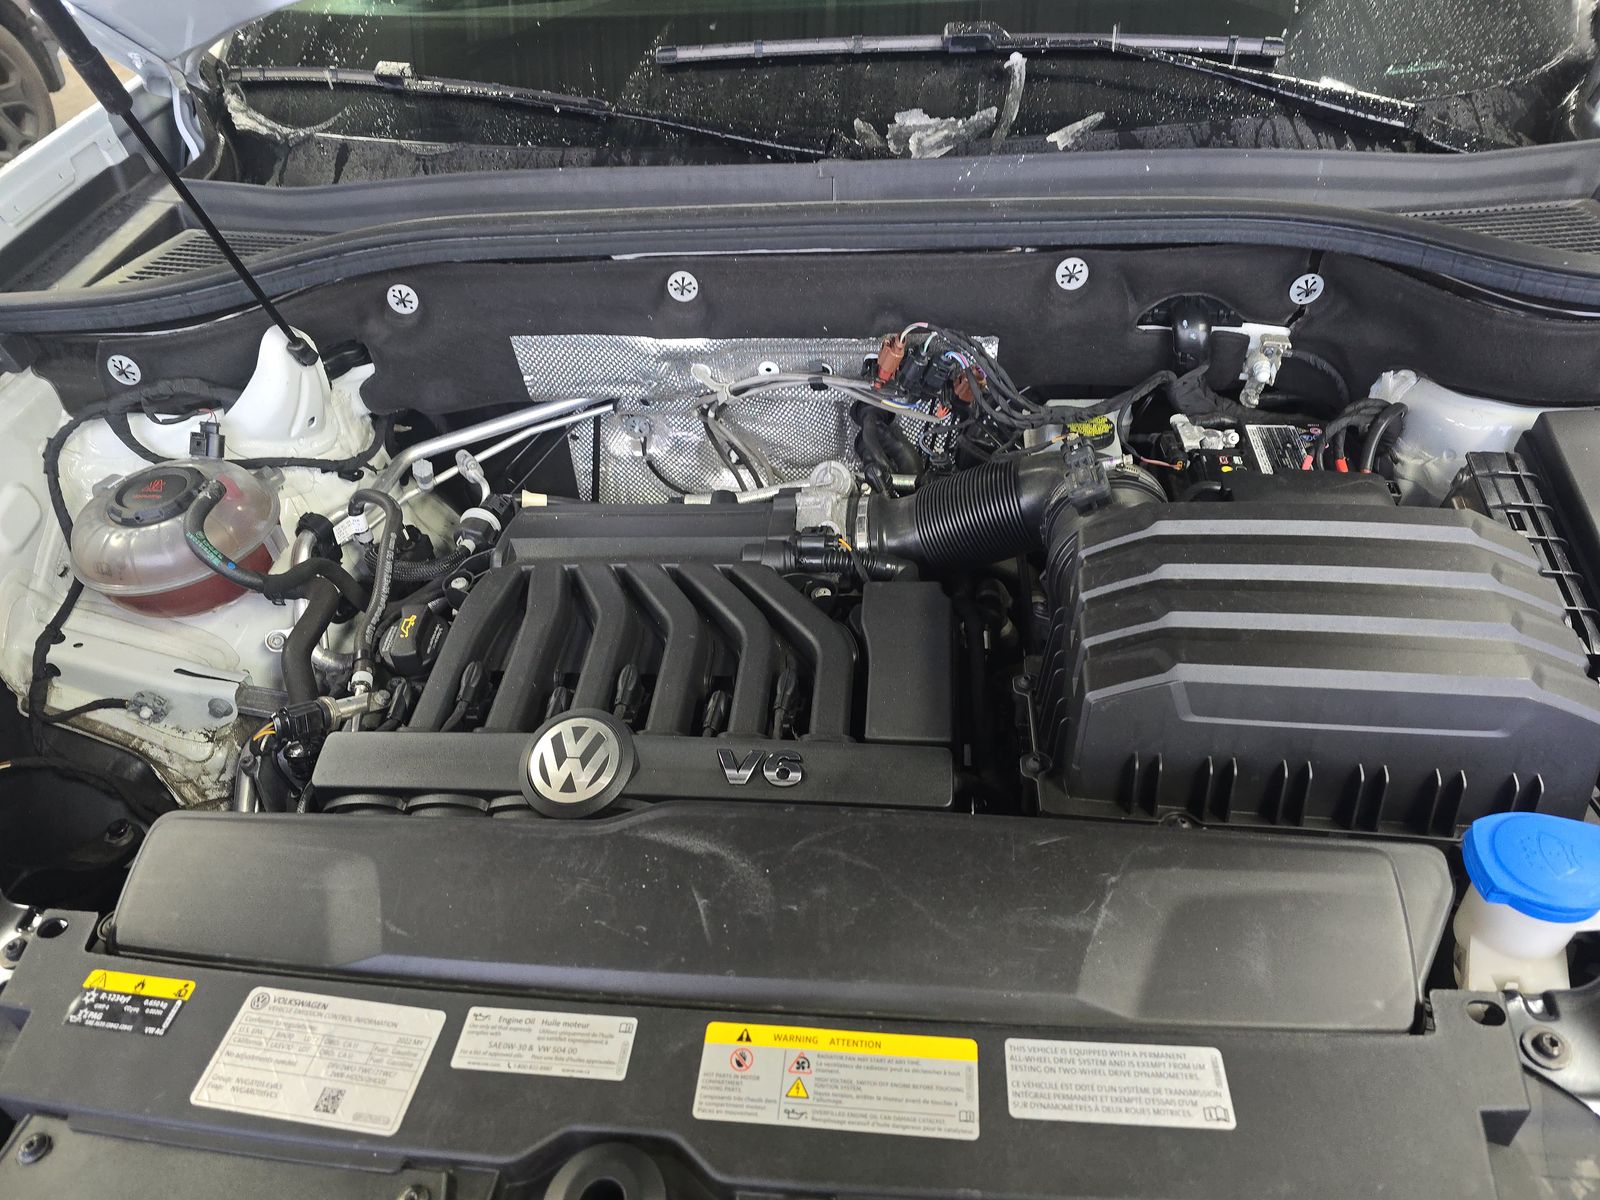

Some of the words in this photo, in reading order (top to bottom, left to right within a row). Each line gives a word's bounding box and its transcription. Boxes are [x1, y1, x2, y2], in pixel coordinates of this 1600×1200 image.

[716, 748, 804, 788] V6
[268, 1005, 293, 1014] VEHICLE
[272, 996, 329, 1010] VOLKSWAGEN
[498, 1015, 524, 1026] Engine
[562, 1020, 590, 1028] moteur
[773, 1033, 819, 1044] WARNING
[829, 1038, 882, 1049] ATTENTION
[537, 1045, 551, 1053] VW
[552, 1046, 566, 1054] 504
[568, 1047, 578, 1055] 00
[1027, 1046, 1059, 1054] VEHICLE
[1068, 1048, 1108, 1057] EQUIPPED
[1140, 1051, 1187, 1060] PERMANENT
[1010, 1055, 1052, 1063] ALL-WHEEL
[1053, 1057, 1075, 1065] DRIVE
[1078, 1058, 1107, 1066] SYSTEM
[1108, 1059, 1126, 1067] AND
[1136, 1061, 1168, 1069] EXEMPT
[1167, 1062, 1191, 1070] FROM
[1011, 1064, 1042, 1073] TESTING
[1044, 1066, 1056, 1074] ON
[1058, 1066, 1107, 1076] TWO-WHEEL
[1108, 1069, 1131, 1077] DRIVE
[1012, 1080, 1021, 1088] CE
[1152, 1087, 1163, 1095] DE
[1165, 1088, 1223, 1098] TRANSMISSION
[1053, 1092, 1098, 1102] PERMANENT
[1100, 1095, 1109, 1103] ET
[1013, 1101, 1028, 1109] SUR
[1102, 1105, 1123, 1114] DEUX
[1124, 1106, 1152, 1115] ROUES
